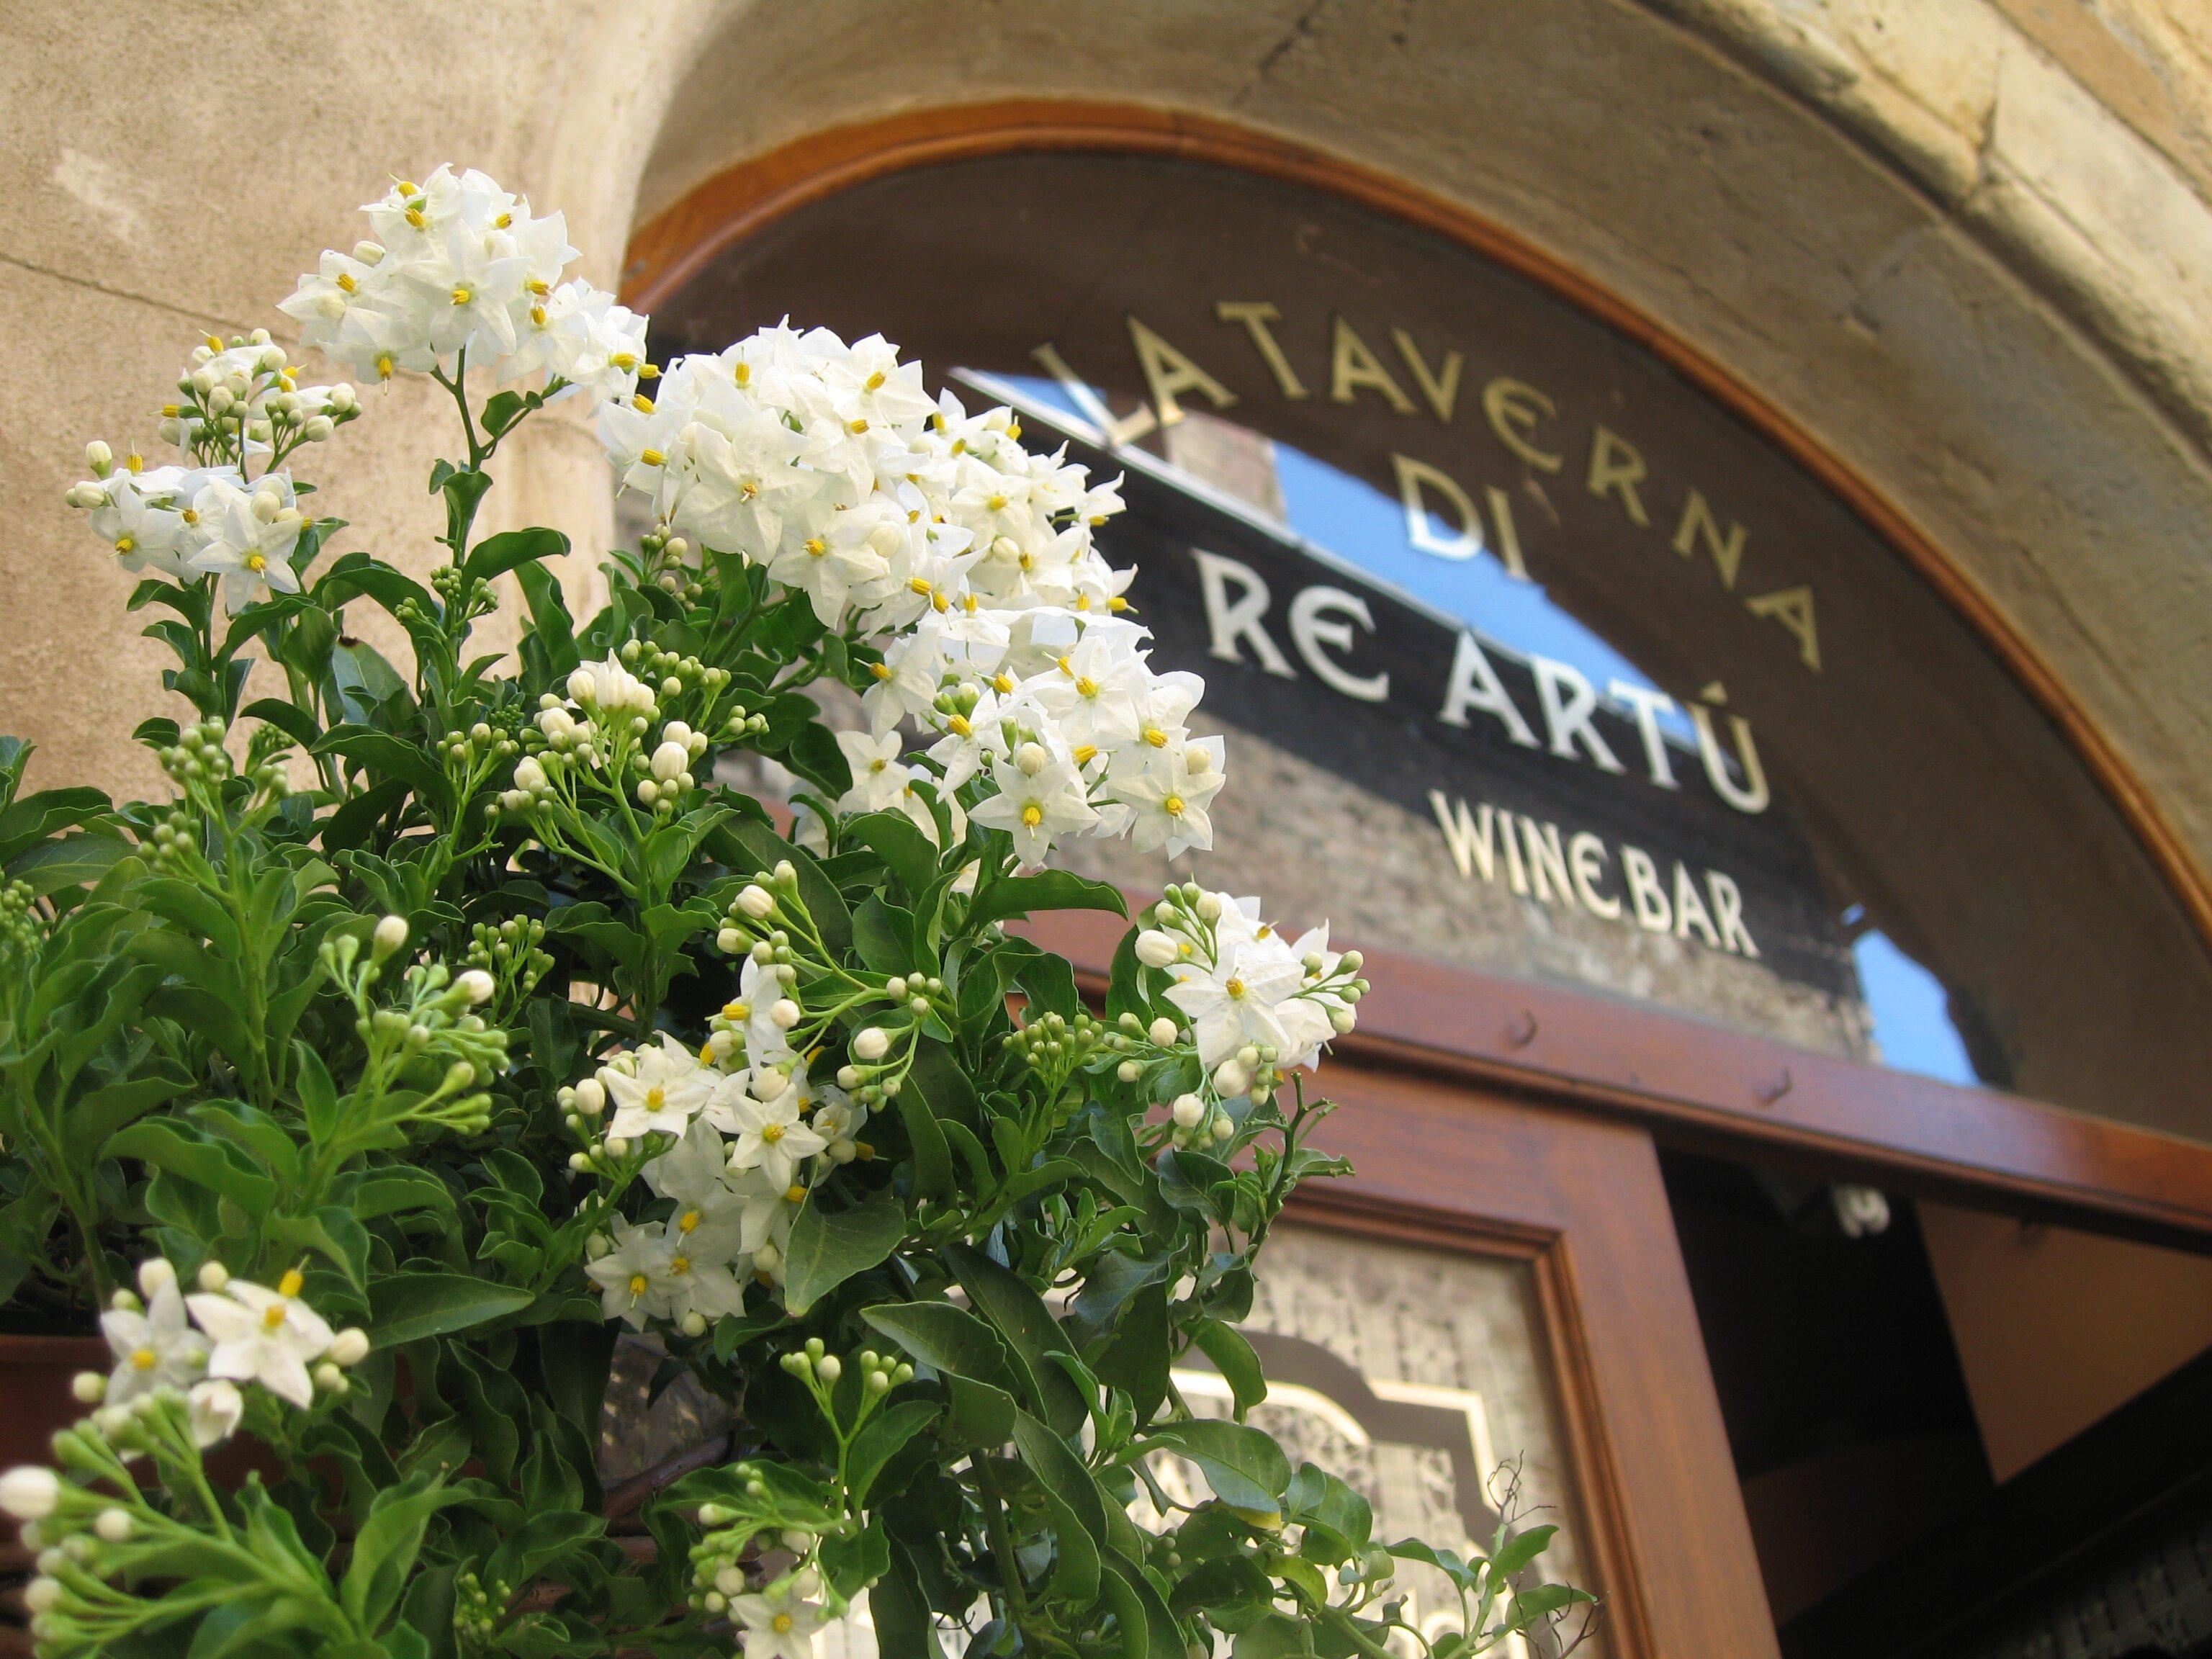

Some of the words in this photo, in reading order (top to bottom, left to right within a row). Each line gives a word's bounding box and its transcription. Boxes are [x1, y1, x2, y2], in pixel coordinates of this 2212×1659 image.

[1031, 315, 1238, 446] LA
[1218, 302, 1822, 671] TAVERNA
[1393, 455, 1529, 581] DI
[1190, 548, 1390, 703] RE
[1429, 789, 1622, 920] WINE
[1620, 845, 1761, 958] BAR
